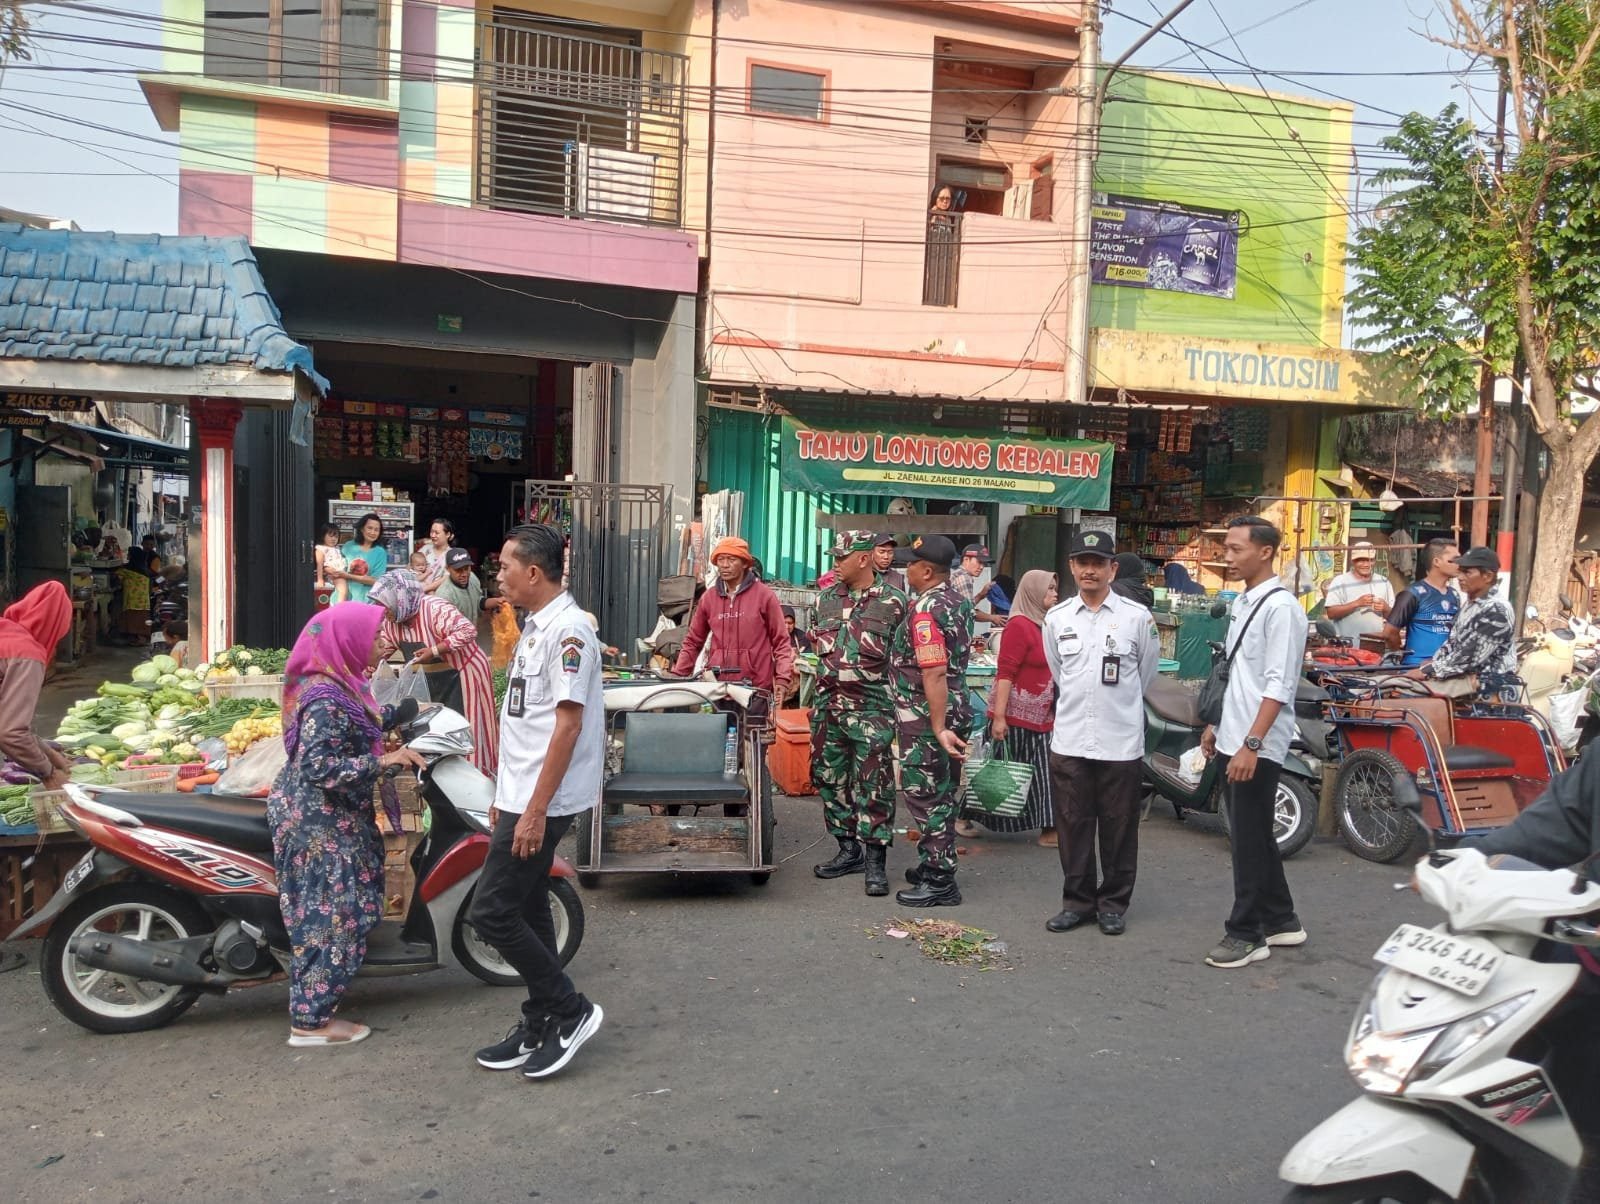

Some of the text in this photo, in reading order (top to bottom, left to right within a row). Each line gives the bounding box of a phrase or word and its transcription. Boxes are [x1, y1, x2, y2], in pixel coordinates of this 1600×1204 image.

[1096, 221, 1123, 231] TASTE
[1095, 231, 1111, 240] THE
[1092, 241, 1126, 252] FLAVOR
[1183, 244, 1219, 260] CAMEL
[1089, 251, 1138, 264] SENSATION
[1184, 348, 1340, 392] TOKOKOSIM
[7, 393, 53, 408] ZAKSE
[796, 430, 1100, 479] TAHU LONTONG KEBALEN
[883, 472, 1016, 488] JL. ZAENAL ZAKSE NO 26 MALANG
[1407, 932, 1457, 958] 3246
[1457, 948, 1499, 974] AAA
